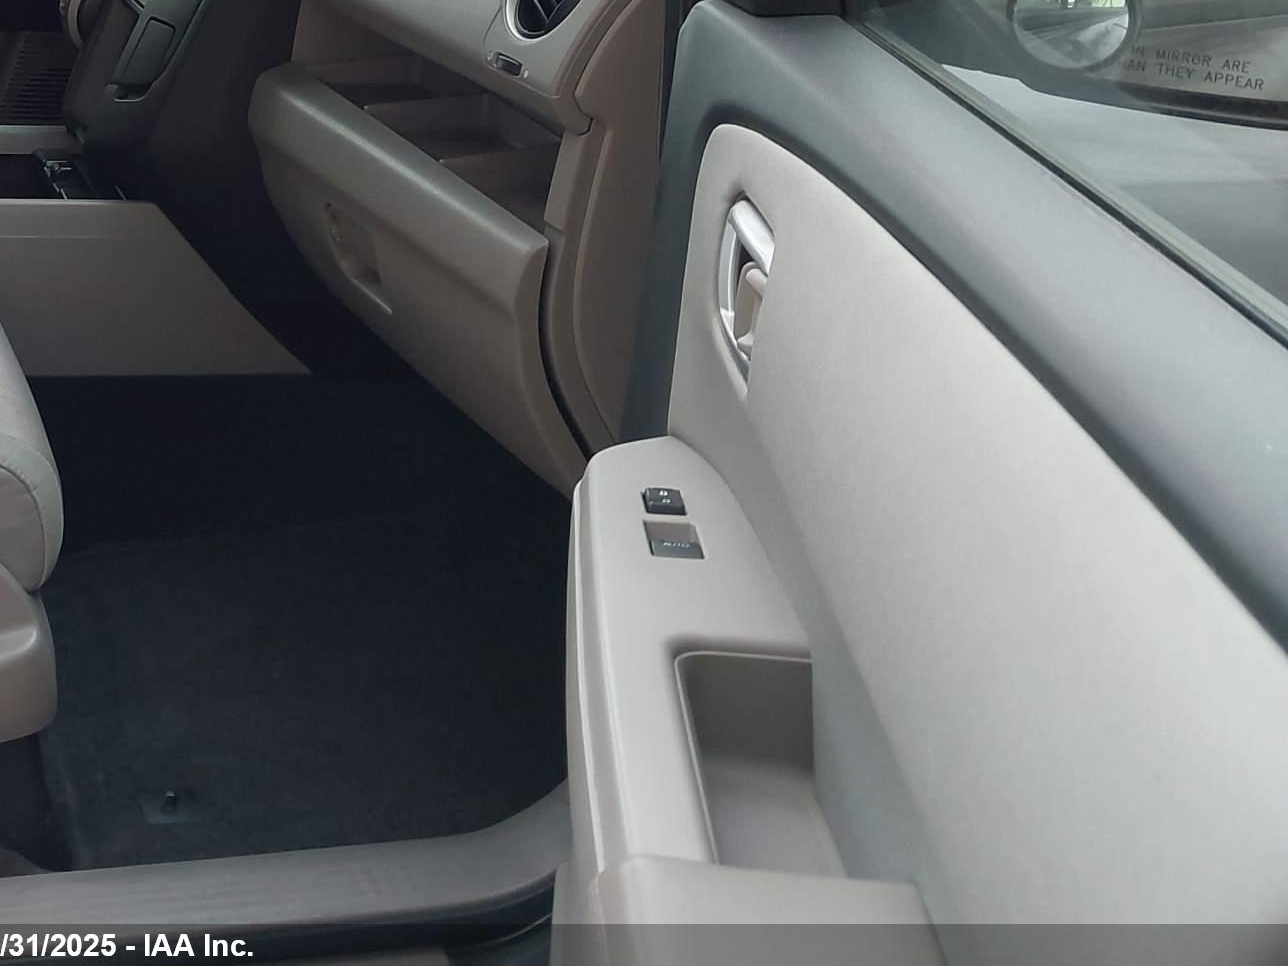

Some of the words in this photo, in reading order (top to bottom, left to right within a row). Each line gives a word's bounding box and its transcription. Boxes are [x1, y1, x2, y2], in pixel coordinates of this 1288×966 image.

[1124, 59, 1146, 72] AN
[1158, 63, 1194, 79] THEY
[1203, 71, 1264, 91] APPEAR
[1156, 49, 1212, 67] MIRROR
[1221, 58, 1251, 74] ARE
